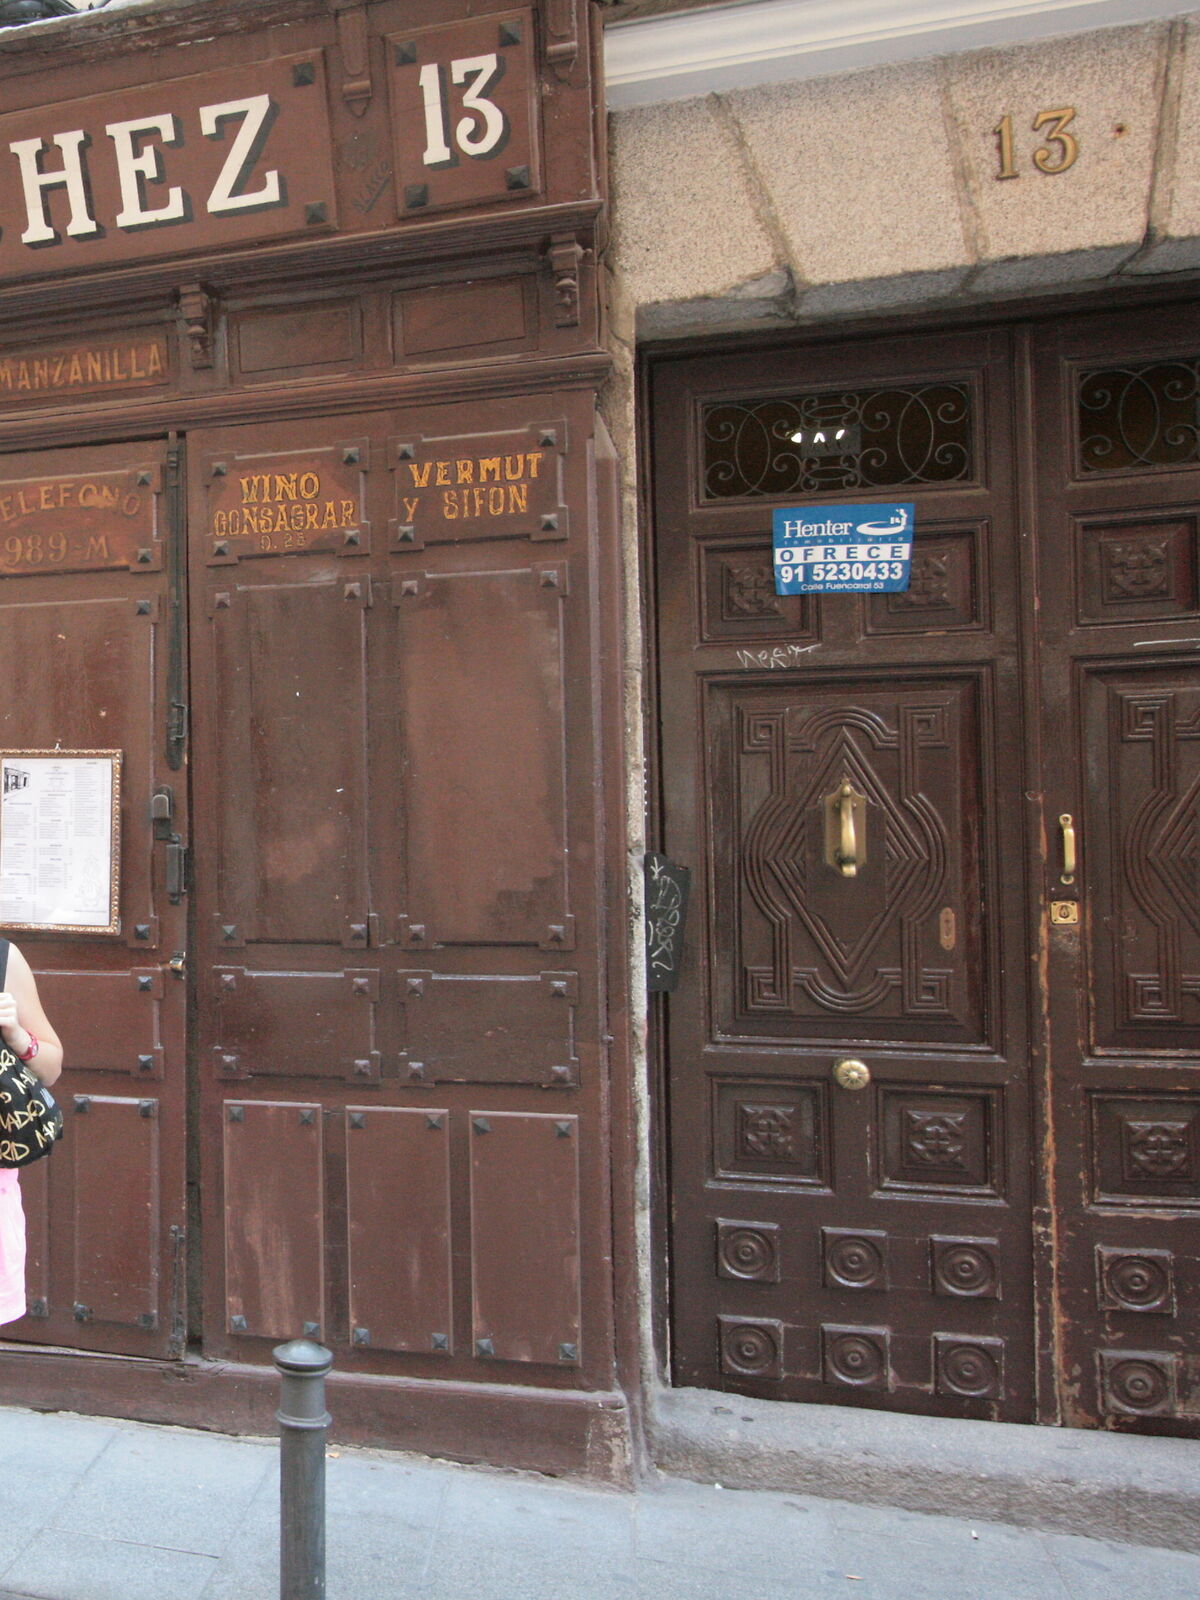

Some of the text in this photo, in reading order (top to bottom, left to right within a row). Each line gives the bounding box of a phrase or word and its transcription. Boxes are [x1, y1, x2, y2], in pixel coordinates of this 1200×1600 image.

[419, 53, 504, 165] 13
[993, 107, 1078, 181] 13
[408, 453, 543, 488] VERMUT
[239, 472, 321, 504] VINO
[402, 484, 529, 522] Y SIFON
[783, 520, 853, 538] Henter
[780, 545, 904, 562] OFRECE
[780, 562, 903, 583] 91 5230433
[800, 583, 823, 591] Calle
